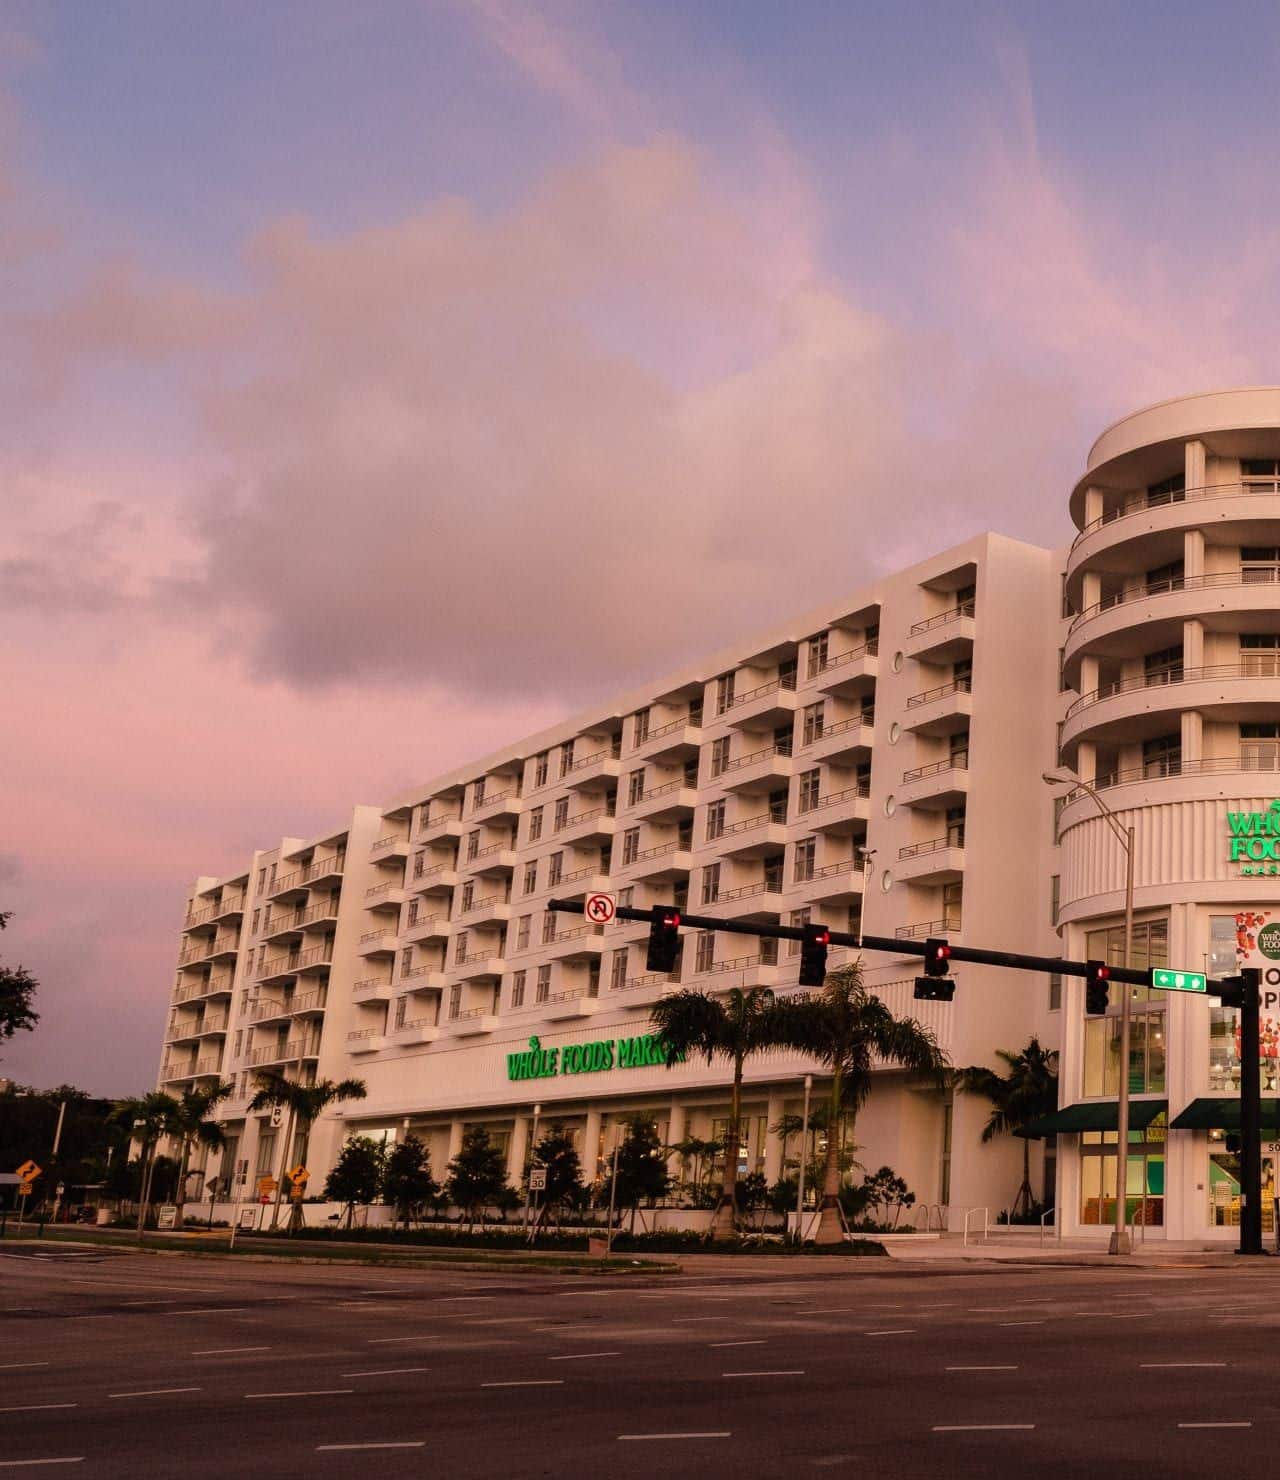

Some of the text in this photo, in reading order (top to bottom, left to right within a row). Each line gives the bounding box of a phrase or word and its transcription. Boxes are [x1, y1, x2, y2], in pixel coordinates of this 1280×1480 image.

[507, 1045, 559, 1081] WHOLE
[560, 1040, 615, 1074] FOODS
[532, 1180, 544, 1188] 30
